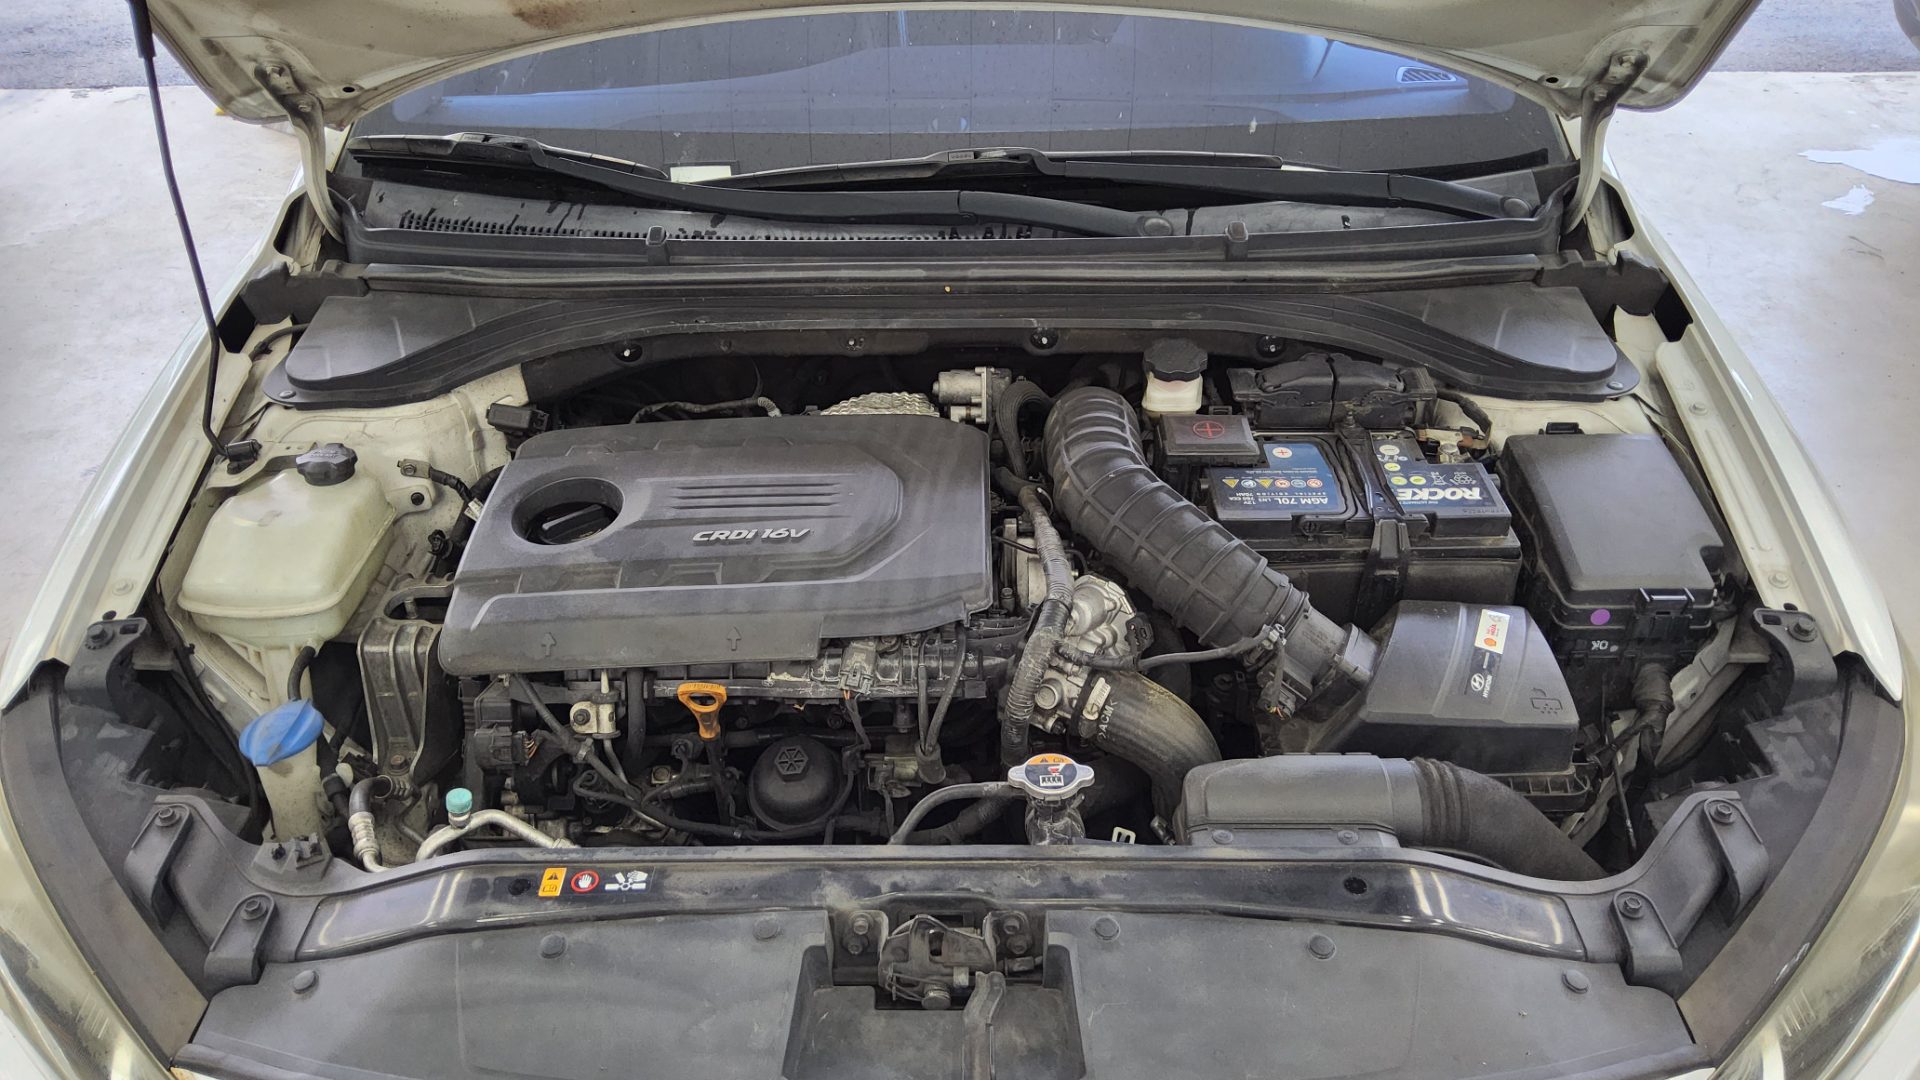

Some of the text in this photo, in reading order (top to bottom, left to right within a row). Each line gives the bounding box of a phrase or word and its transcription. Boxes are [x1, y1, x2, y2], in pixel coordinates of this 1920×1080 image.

[1396, 487, 1482, 500] ROCKE
[1274, 497, 1298, 505] 70L
[761, 528, 811, 540] 16V
[1482, 674, 1492, 698] HYUNDAI
